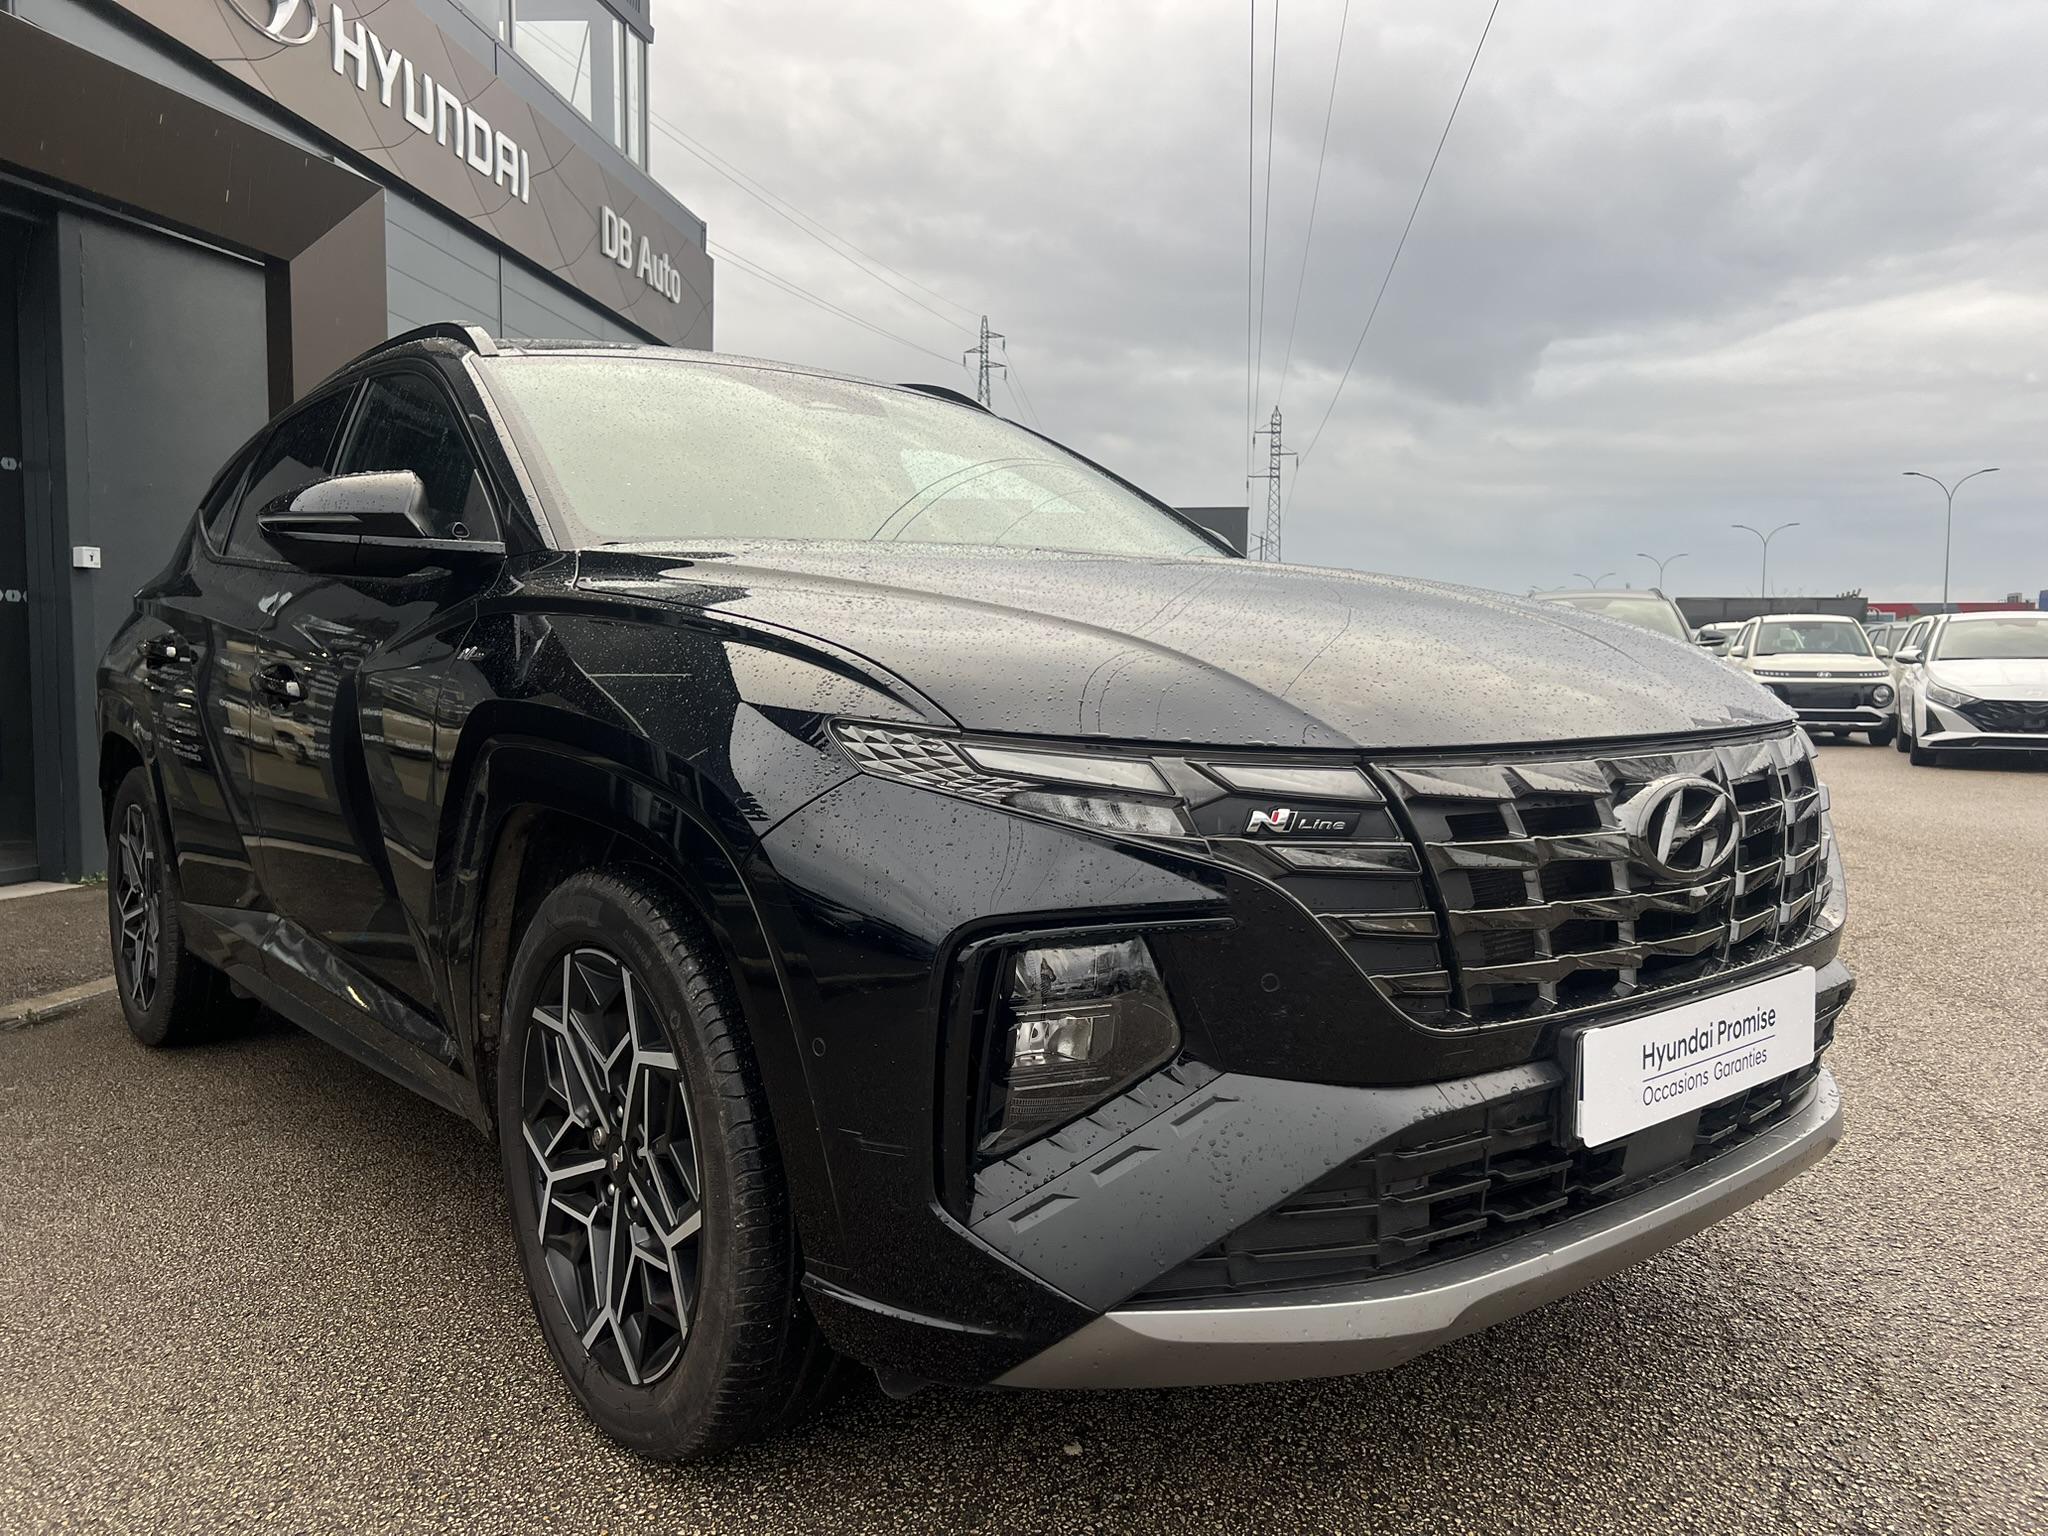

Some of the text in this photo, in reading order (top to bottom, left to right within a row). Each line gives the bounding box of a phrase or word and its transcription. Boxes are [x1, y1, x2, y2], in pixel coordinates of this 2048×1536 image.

[330, 4, 531, 204] HYUNDAI
[600, 205, 681, 304] DB Auto
[1298, 818, 1346, 830] Line
[1642, 1006, 1776, 1070] Hyundai Promise
[1642, 1048, 1768, 1106] Occasions Garanties
